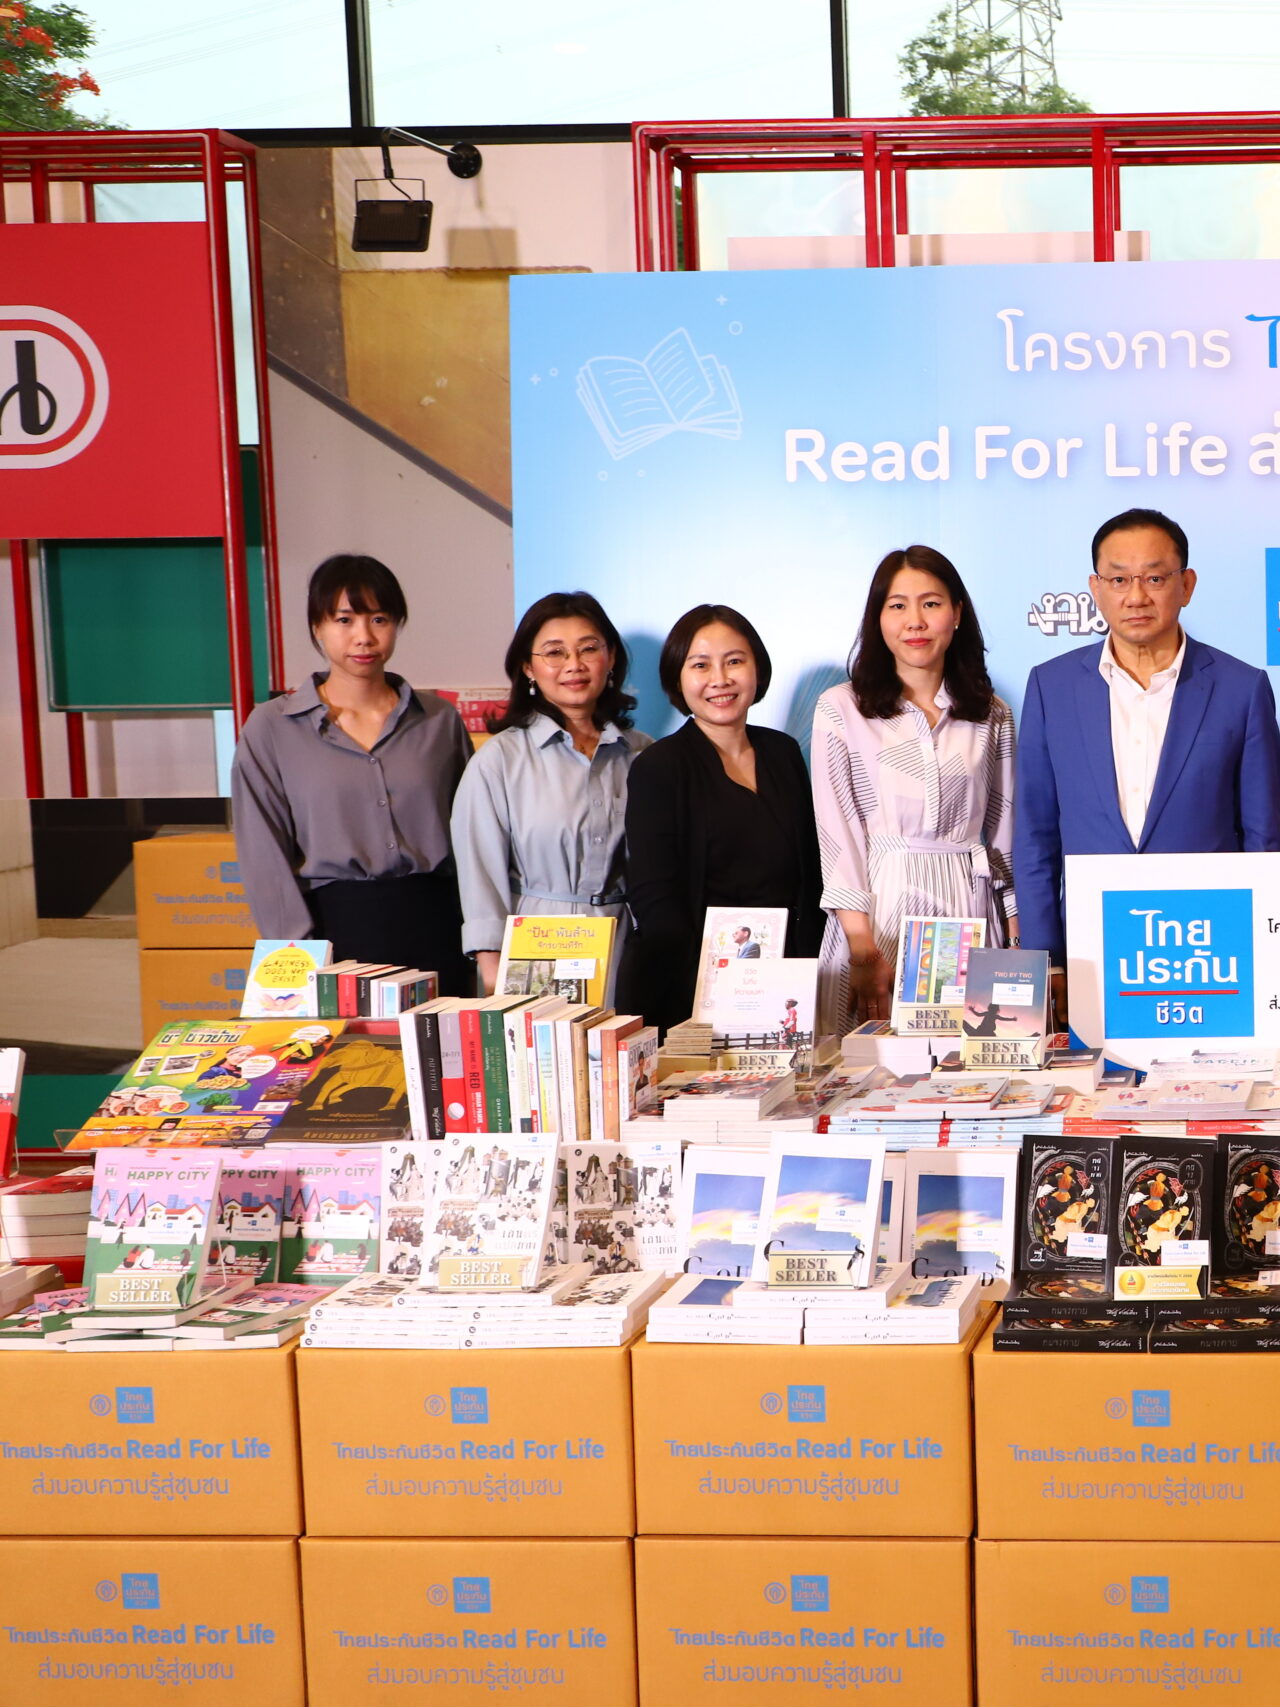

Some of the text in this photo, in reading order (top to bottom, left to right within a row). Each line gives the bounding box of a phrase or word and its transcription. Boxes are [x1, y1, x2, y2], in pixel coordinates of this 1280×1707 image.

[997, 308, 1231, 372] โครงการ
[785, 427, 950, 483] Read
[975, 426, 1083, 480] For
[1105, 421, 1228, 478] Life
[1128, 909, 1211, 947] ไทย
[1119, 950, 1239, 985] ประกัน
[907, 1019, 958, 1030] SELLER
[915, 1009, 950, 1019] BEST
[1156, 1002, 1204, 1025] ชีวิต
[971, 1053, 1030, 1064] SELLER
[981, 1042, 1021, 1053] BEST
[738, 1055, 778, 1066] BEST
[127, 1171, 210, 1181] HAPPY CITY
[248, 1170, 278, 1179] CITY
[297, 1167, 374, 1177] HAPPY CITY
[459, 1261, 503, 1273] BEST
[785, 1257, 828, 1270] BEST
[119, 1278, 163, 1291] BEST
[450, 1273, 511, 1285] SELLER
[775, 1269, 837, 1282] SELLER
[108, 1290, 172, 1303] SELLER
[125, 1437, 183, 1460] Read
[188, 1438, 226, 1460] For
[230, 1436, 272, 1460] Life
[459, 1438, 516, 1461] Read
[522, 1439, 560, 1460] For
[565, 1437, 606, 1460] Life
[795, 1436, 853, 1460] Read
[859, 1437, 898, 1460] For
[902, 1436, 944, 1460] Life
[1140, 1441, 1198, 1464] Read
[1204, 1443, 1242, 1464] For
[31, 1472, 231, 1501] ส่งมอบความรู้สู่ชุมชน
[364, 1472, 564, 1502] ส่งมอบความรู้สู่ชุมชน
[697, 1471, 901, 1502] ส่งมอบความรู้สู่ชุมชน
[1040, 1476, 1246, 1506] ส่งมอบความรู้สู่ชุมชน
[131, 1623, 188, 1645] Read
[193, 1624, 231, 1645] For
[235, 1623, 277, 1645] Life
[462, 1627, 519, 1649] Read
[525, 1628, 562, 1649] For
[567, 1626, 608, 1649] Life
[799, 1625, 857, 1648] Read
[862, 1627, 900, 1649] For
[905, 1626, 946, 1649] Life
[1138, 1627, 1196, 1649] Read
[1202, 1628, 1240, 1649] For
[37, 1656, 236, 1686] ส่งมอบความรู้สู่ชุมชน
[367, 1661, 566, 1691] ส่งมอบความรู้สู่ชุมชน
[702, 1659, 904, 1690] ส่งมอบความรู้สู่ชุมชน
[1040, 1661, 1243, 1691] ส่งมอบความรู้สู่ชุมชน
